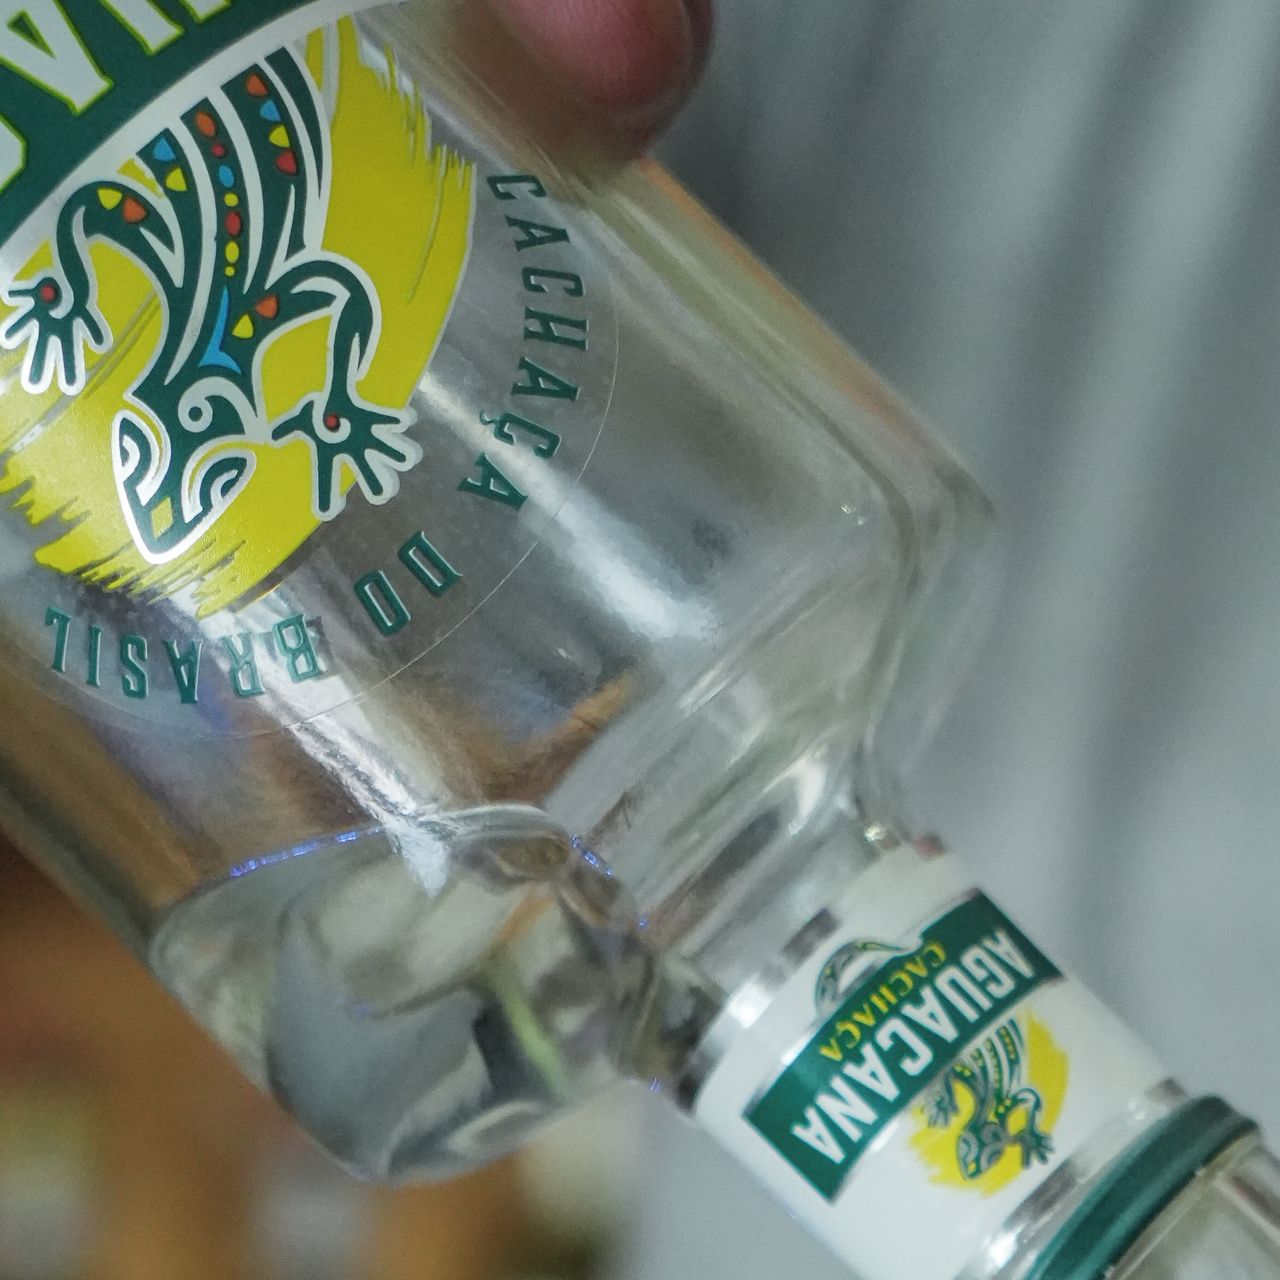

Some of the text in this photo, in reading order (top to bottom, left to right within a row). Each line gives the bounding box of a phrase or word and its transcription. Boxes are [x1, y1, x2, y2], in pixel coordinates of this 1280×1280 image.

[45, 174, 590, 704] CACHAÇA DO BRASIL
[790, 928, 1035, 1165] AGUACANA
